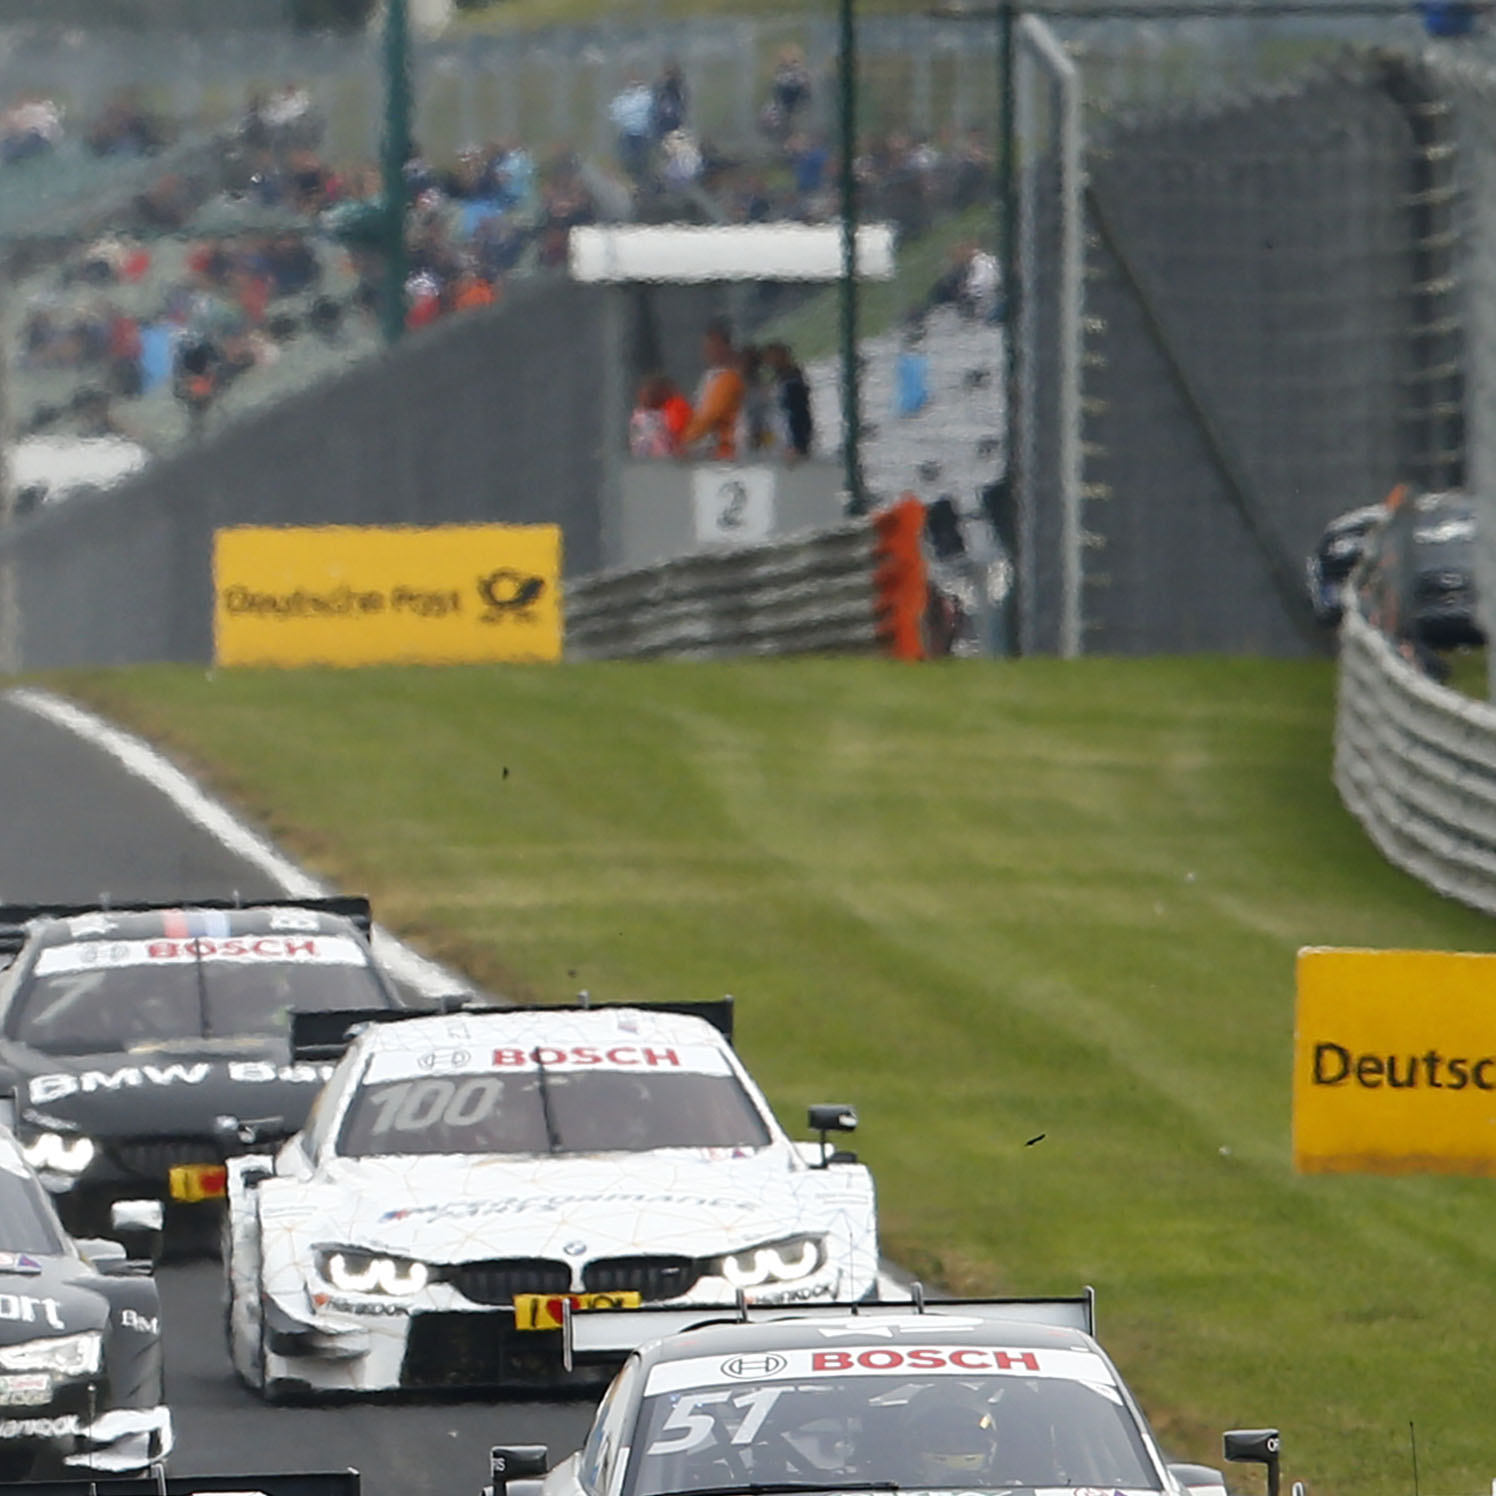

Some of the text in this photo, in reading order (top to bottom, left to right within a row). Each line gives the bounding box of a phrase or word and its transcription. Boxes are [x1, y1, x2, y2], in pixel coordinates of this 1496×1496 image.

[714, 479, 750, 527] 2
[225, 582, 462, 618] Deutsche Post
[147, 938, 318, 960] BOSCH
[31, 971, 108, 1025] 7
[491, 1046, 681, 1069] BOSCH
[27, 1063, 212, 1105] BMW
[369, 1076, 505, 1136] 100
[811, 1349, 1042, 1373] BOSCH
[645, 1385, 798, 1458] 51
